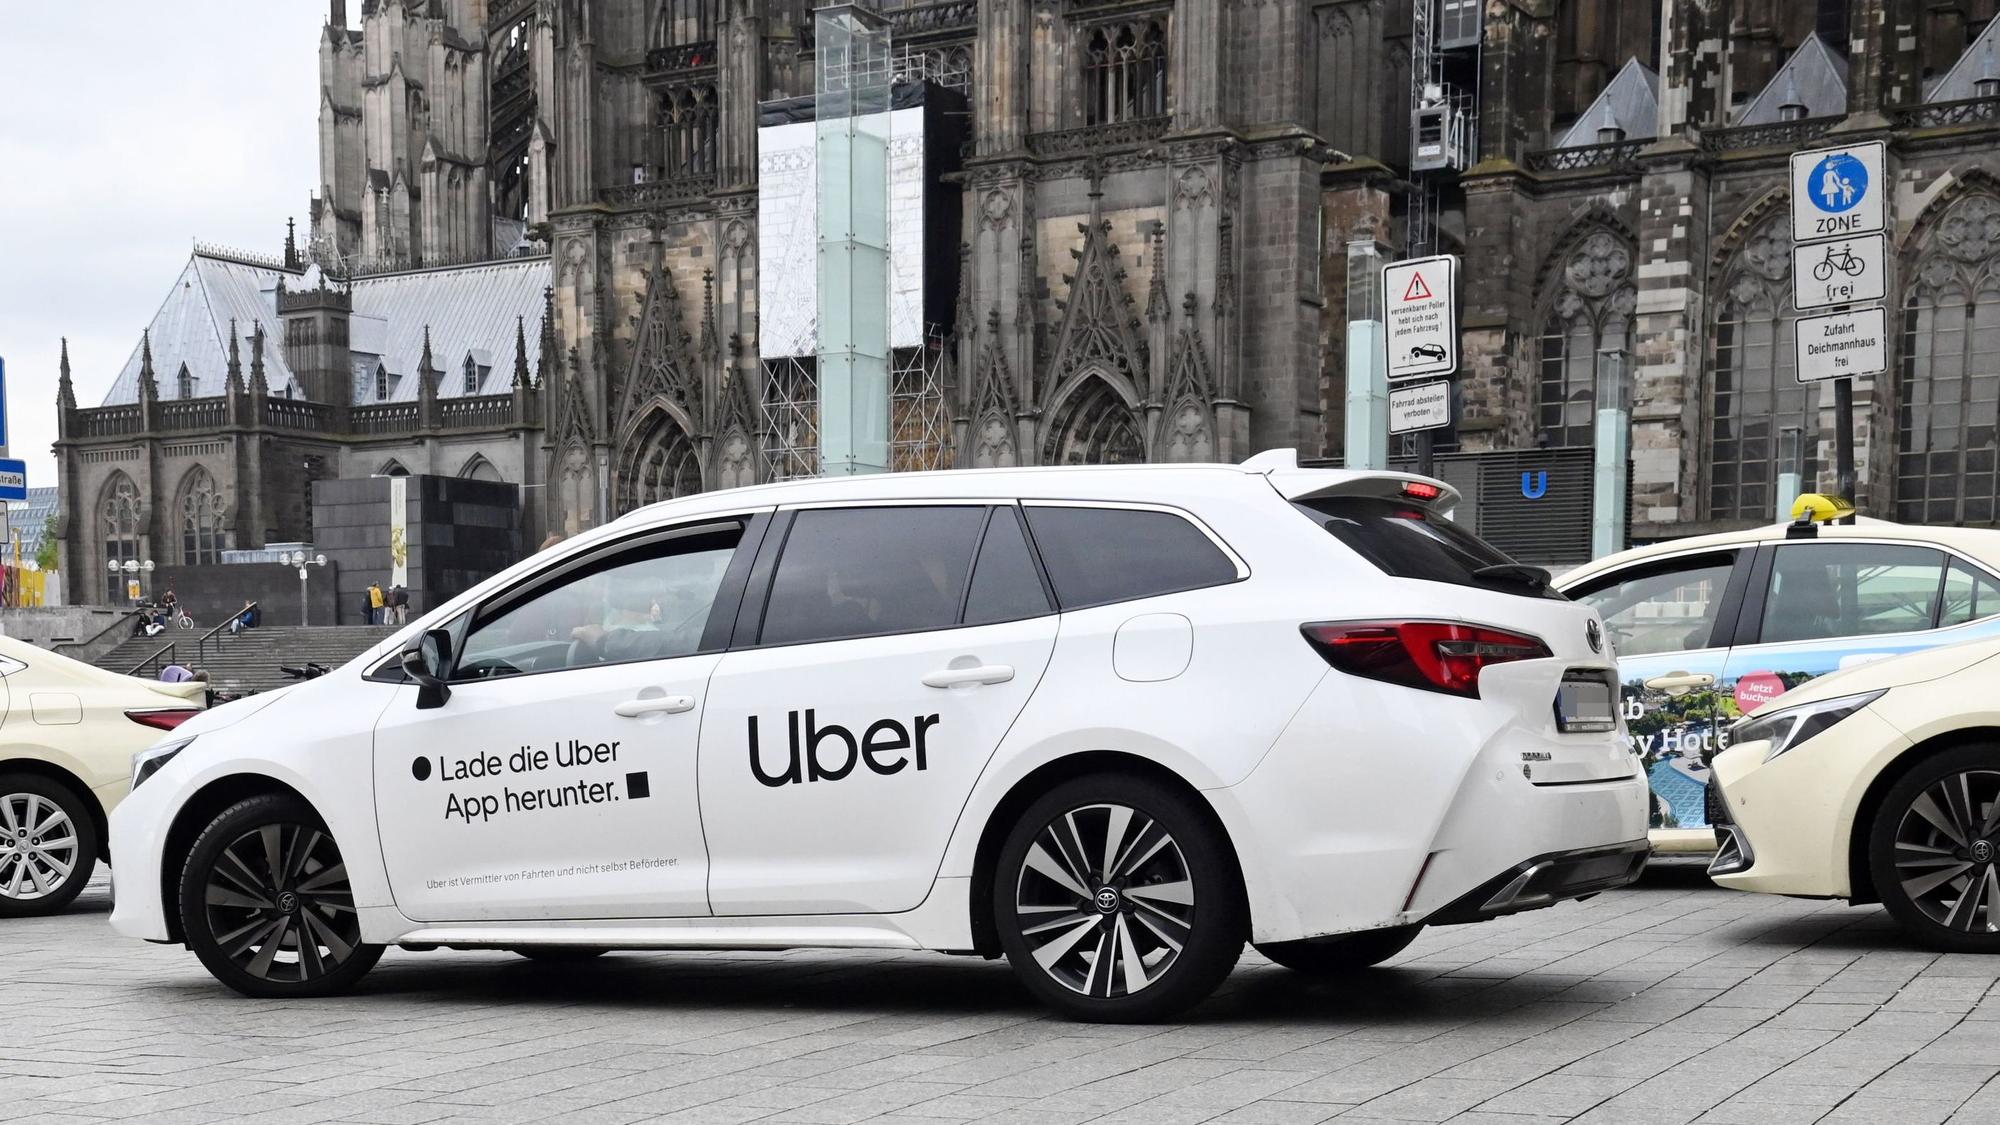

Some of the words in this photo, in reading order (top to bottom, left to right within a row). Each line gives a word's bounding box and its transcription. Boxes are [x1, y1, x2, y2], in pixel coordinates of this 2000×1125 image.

[1816, 214, 1862, 233] ZONE
[1826, 281, 1854, 297] frei
[1391, 304, 1428, 316] versenkbarer
[1429, 301, 1446, 310] Poller
[1398, 316, 1411, 325] hebt
[1411, 314, 1424, 323] sich
[1424, 312, 1439, 321] nach
[1394, 327, 1412, 338] jedem
[1823, 323, 1855, 337] Zufahrt
[1807, 337, 1876, 355] Deichmannhaus
[1834, 356, 1849, 367] frei
[1391, 398, 1415, 408] Fahrrad
[1416, 394, 1445, 405] abstellen
[1403, 408, 1431, 418] verboten
[0, 475, 22, 485] traße
[1521, 471, 1547, 498] U
[1748, 682, 1773, 694] Jetzt
[748, 708, 940, 788] Uber
[440, 751, 502, 781] Lade
[509, 746, 549, 773] die
[555, 739, 620, 767] Uber
[445, 792, 499, 824] App
[504, 780, 620, 812] herunter.
[426, 879, 448, 889] Uber
[448, 877, 459, 887] ist
[460, 873, 503, 887] Vermittler
[504, 872, 520, 881] von
[521, 869, 555, 880] Fahrten
[557, 866, 574, 877] und
[576, 863, 599, 875] nicht
[601, 861, 628, 873] selbst
[629, 857, 680, 870] Beförderer.
